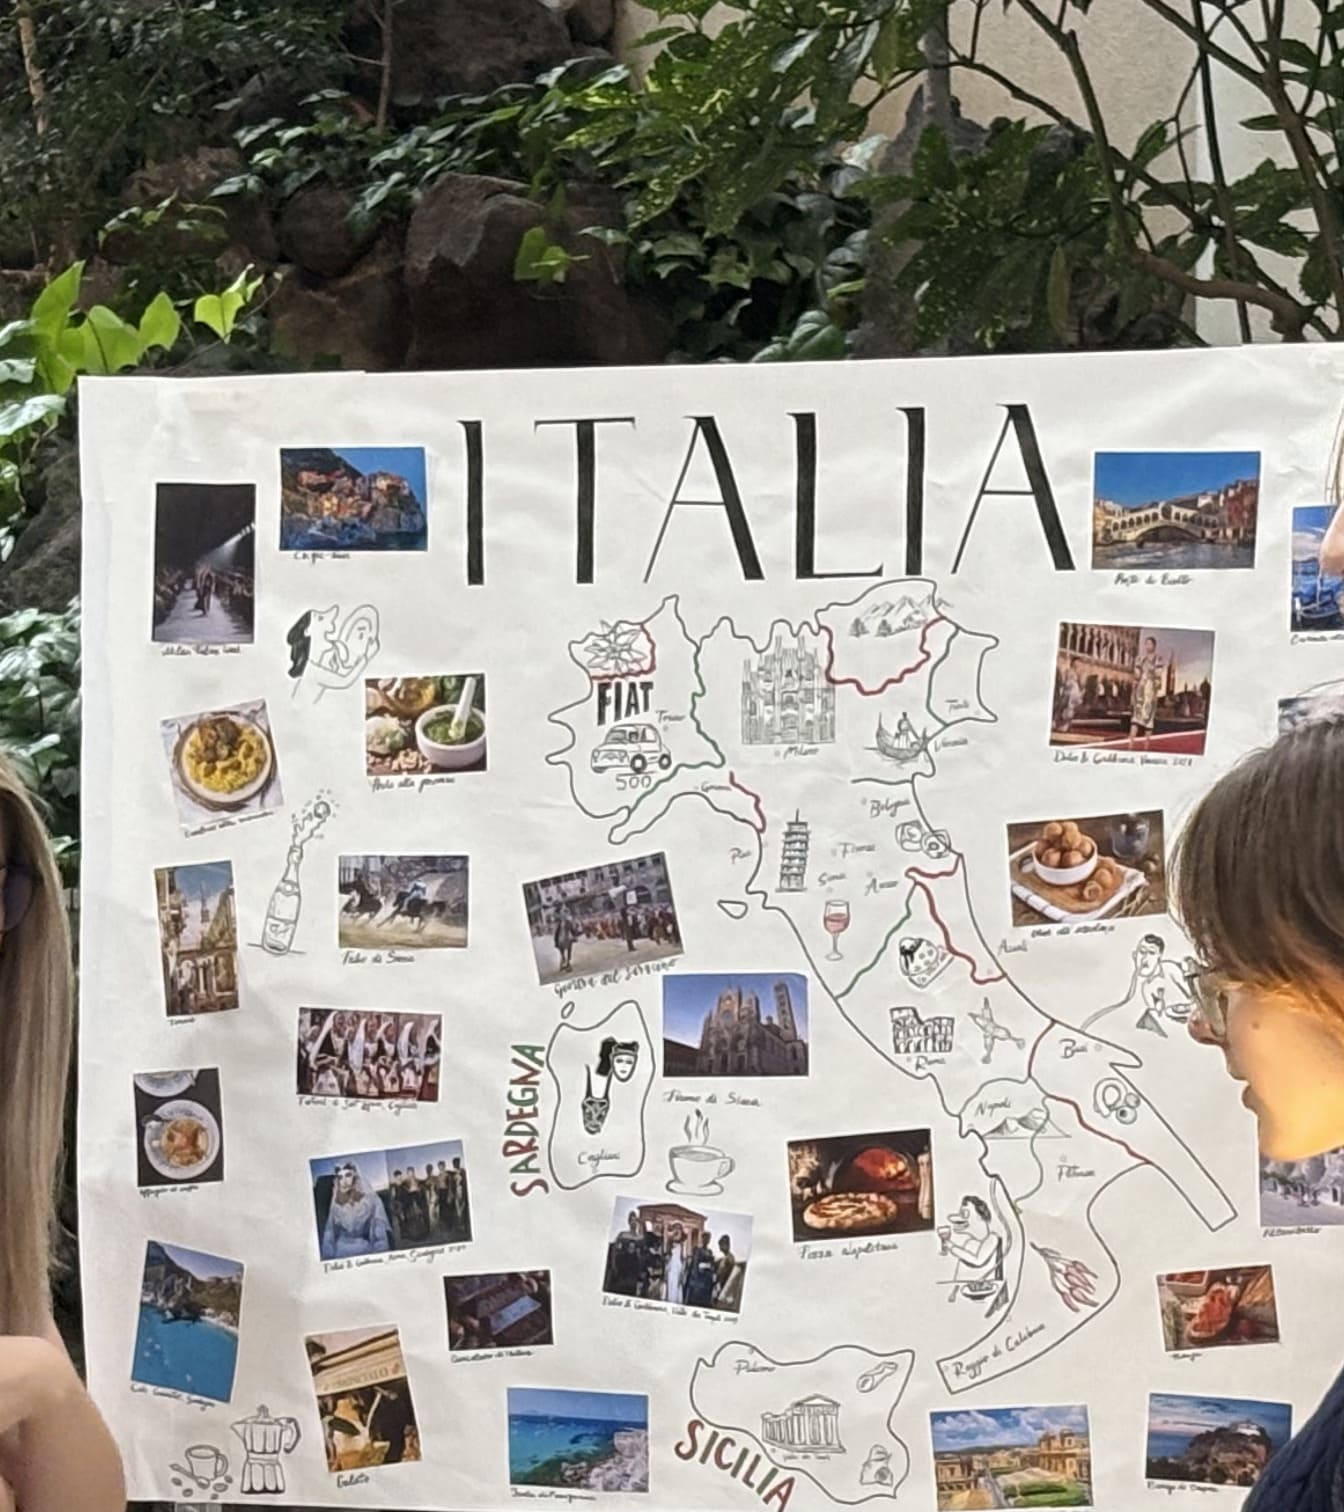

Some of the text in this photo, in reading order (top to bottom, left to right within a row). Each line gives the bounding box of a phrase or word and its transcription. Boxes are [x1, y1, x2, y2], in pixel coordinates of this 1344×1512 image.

[456, 402, 1076, 586] ITALIA
[597, 681, 654, 727] FIAT
[615, 773, 653, 792] 500
[502, 1044, 549, 1197] SARDEGNA
